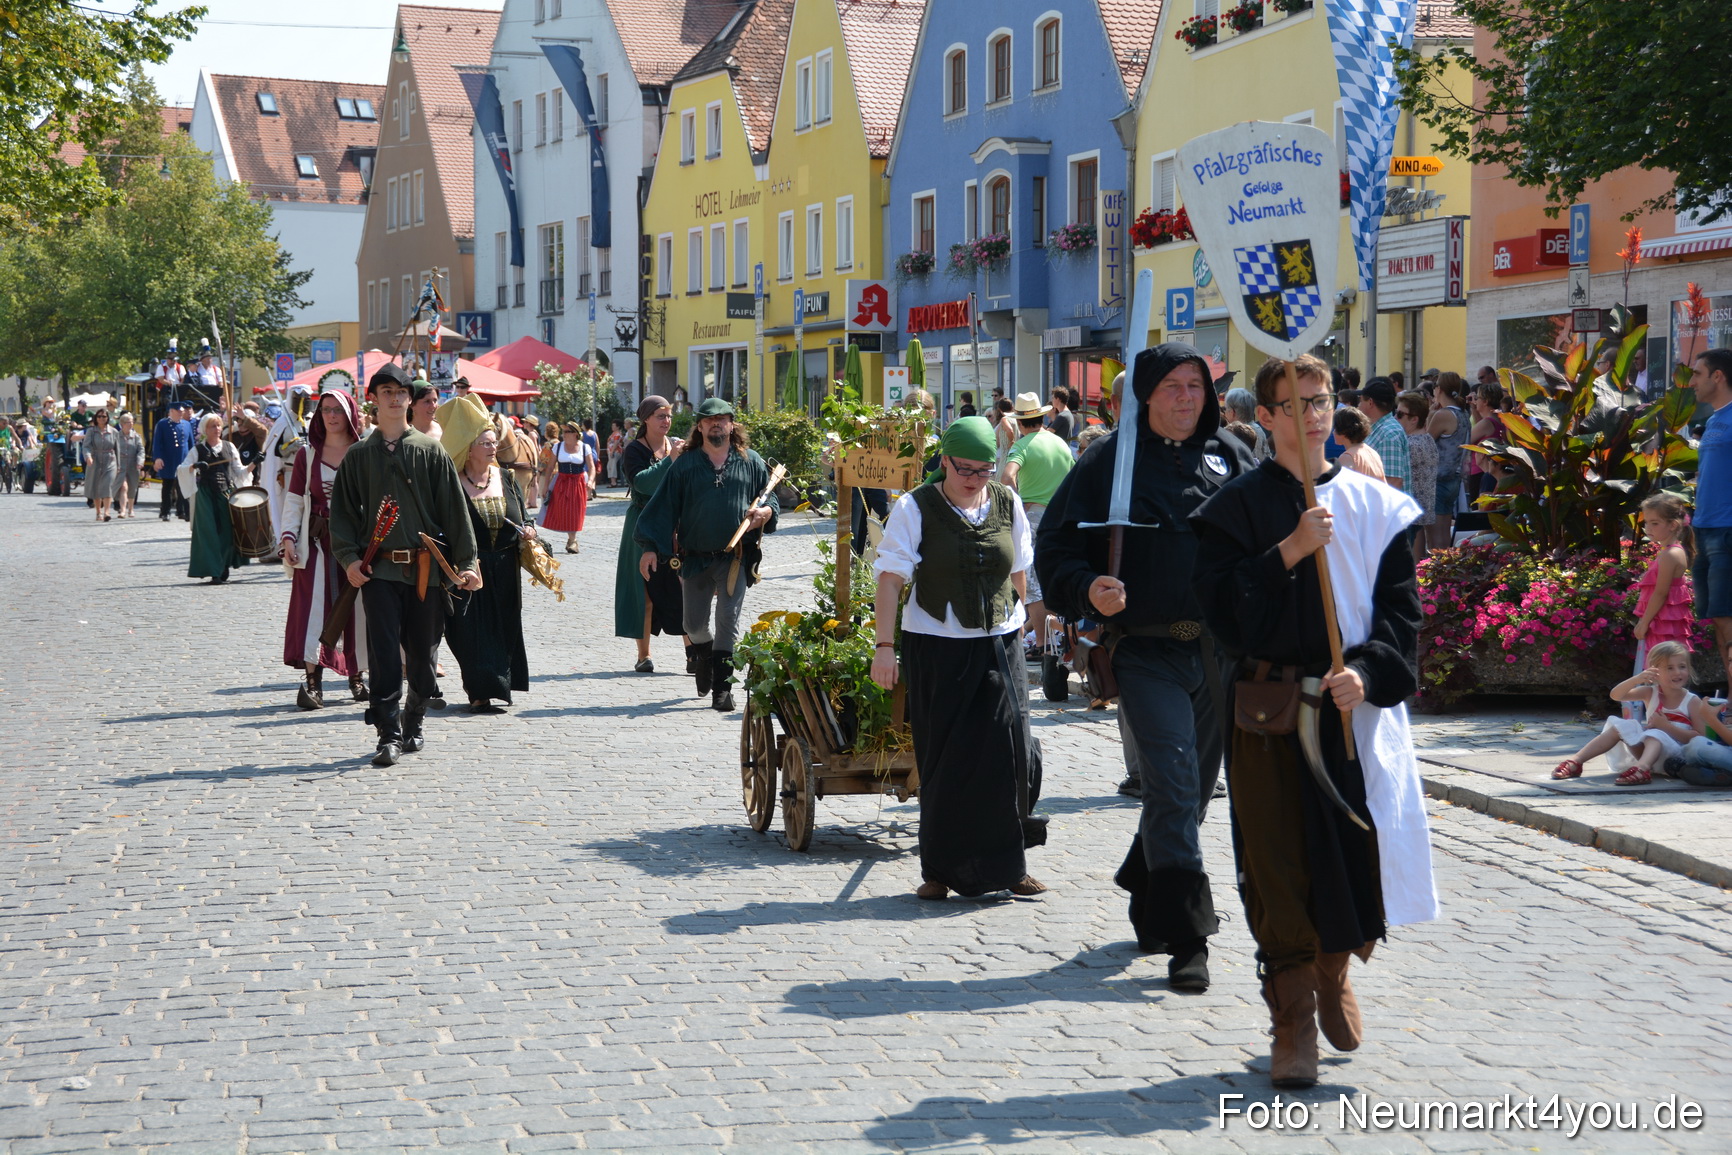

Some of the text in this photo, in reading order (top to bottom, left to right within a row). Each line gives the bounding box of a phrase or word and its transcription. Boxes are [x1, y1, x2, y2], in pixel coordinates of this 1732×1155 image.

[1193, 140, 1323, 185] Pfalzgräfisches
[1394, 160, 1420, 172] KINO
[1104, 192, 1123, 209] CAFÉ
[1243, 181, 1283, 197] Gefolge
[695, 186, 761, 219] HOTEL Lehmeier
[1228, 197, 1306, 225] Neumarkt
[1574, 212, 1585, 256] P
[1105, 213, 1121, 296] WITTL
[1388, 254, 1434, 275] RIALTO KINO
[1450, 221, 1460, 299] KINO
[1494, 252, 1511, 270] DER
[1172, 293, 1189, 326] P
[460, 316, 488, 340] KL
[693, 321, 731, 340] Restaurant
